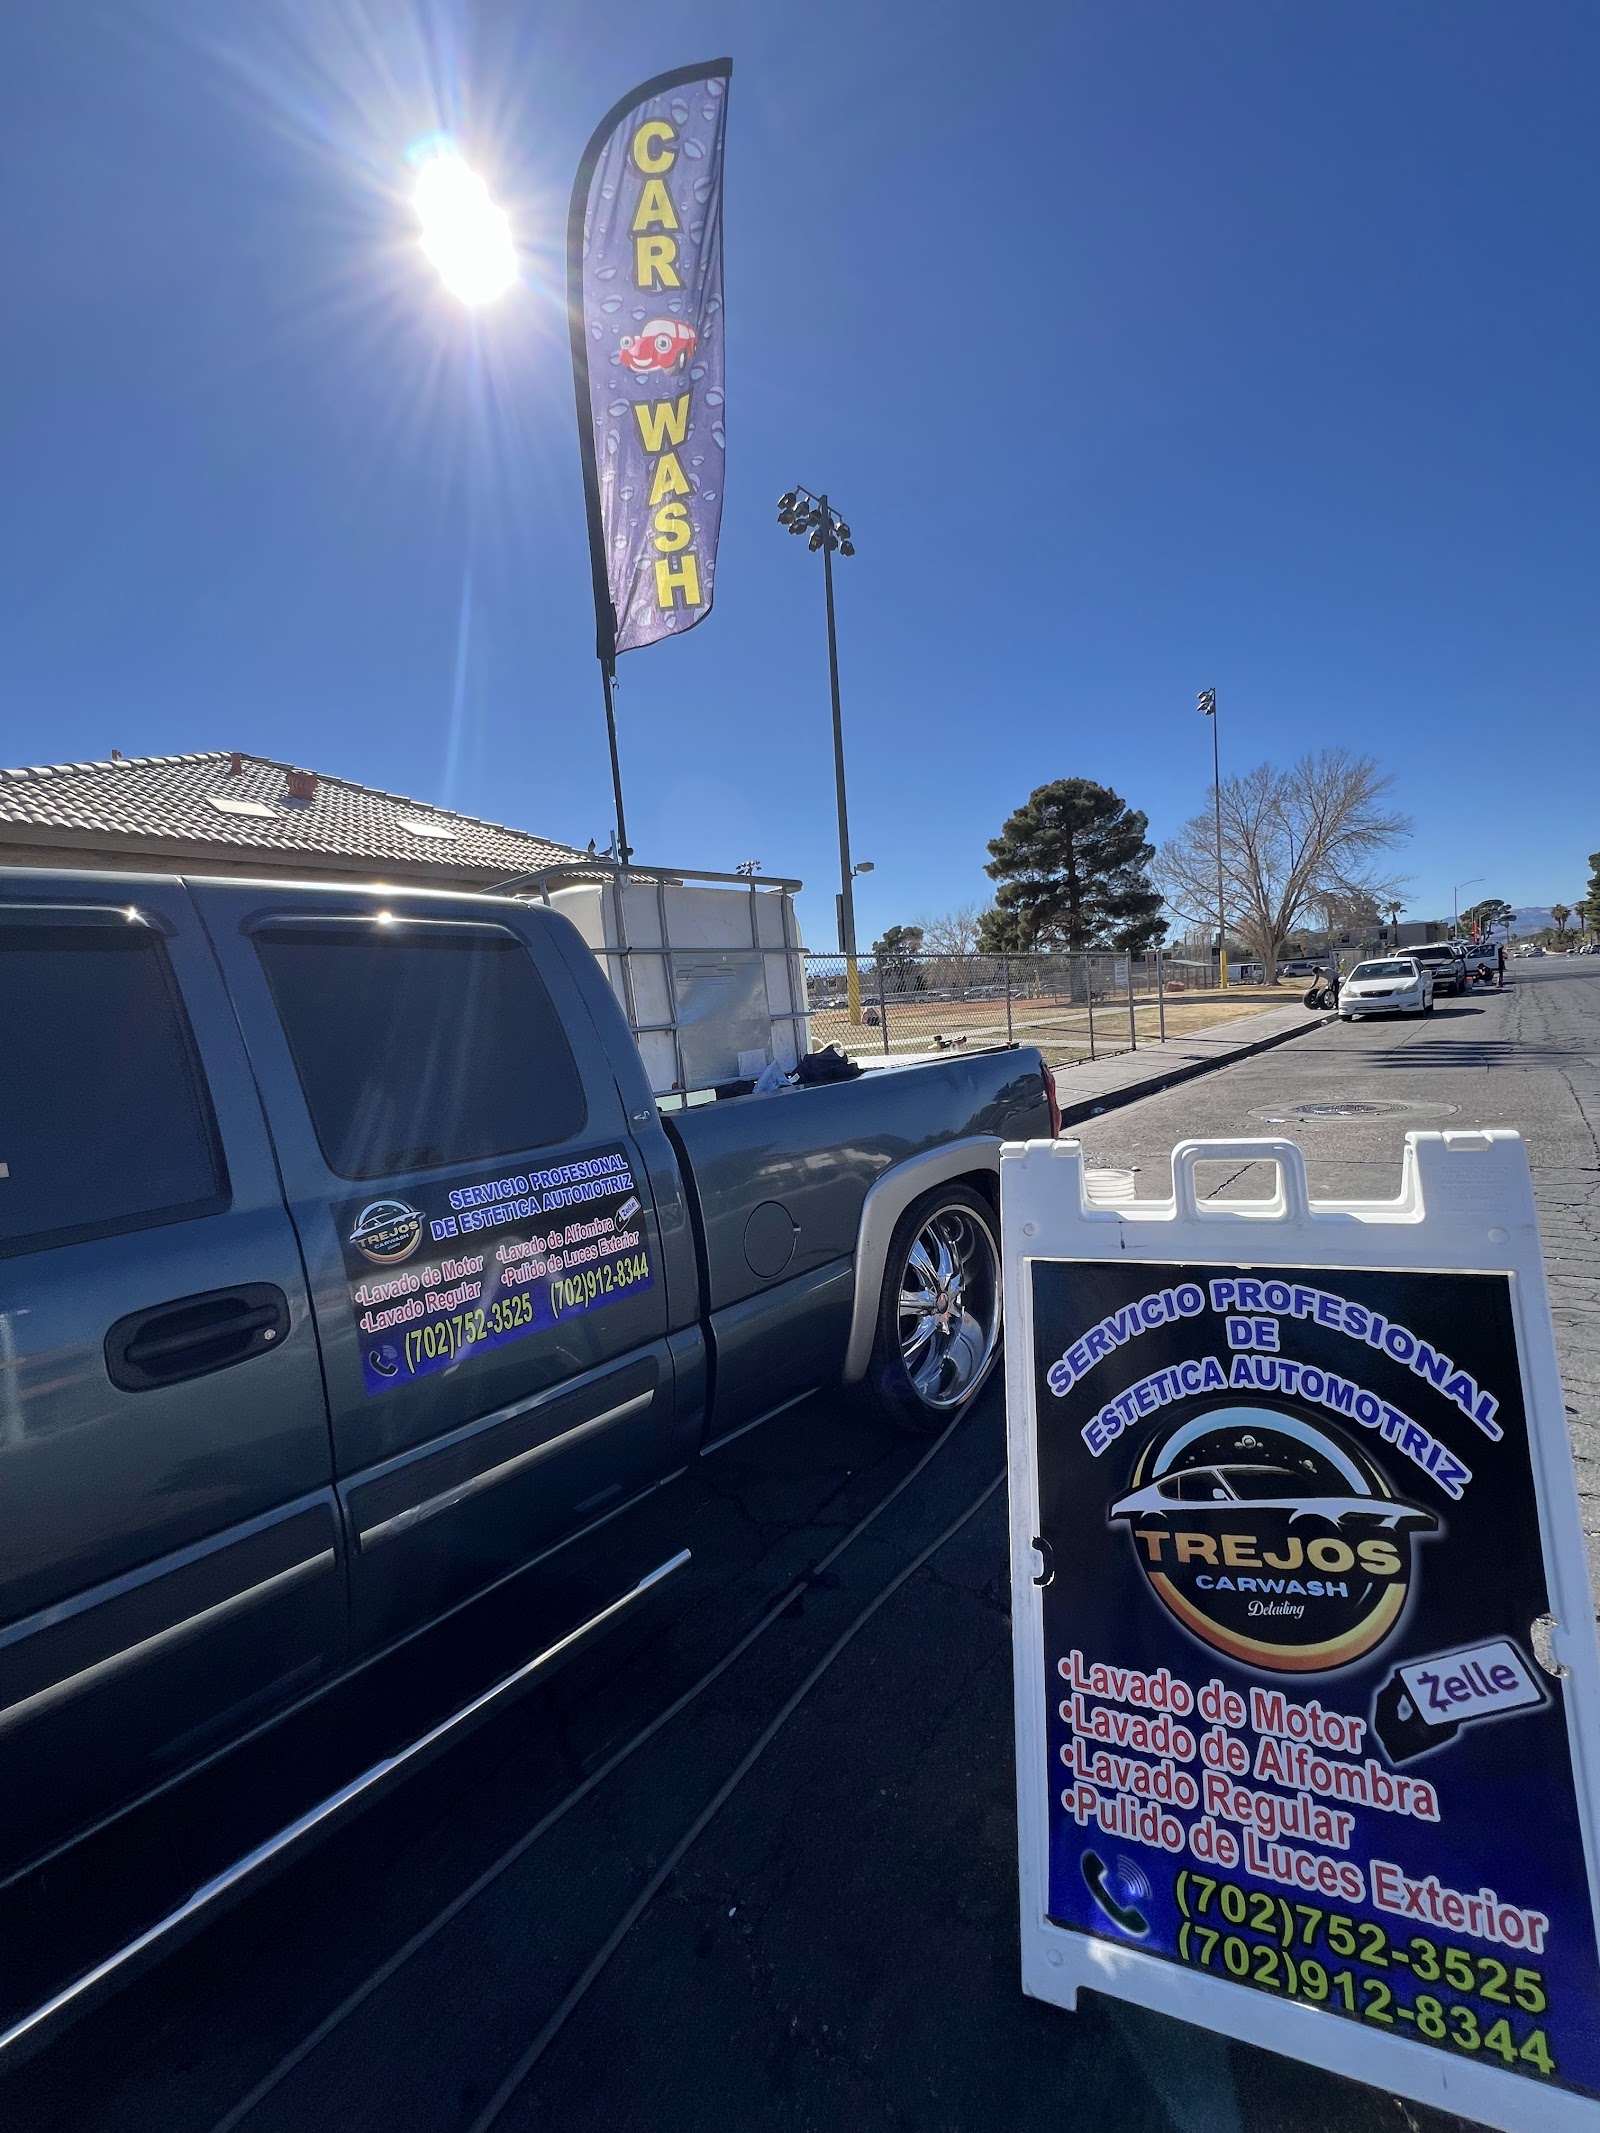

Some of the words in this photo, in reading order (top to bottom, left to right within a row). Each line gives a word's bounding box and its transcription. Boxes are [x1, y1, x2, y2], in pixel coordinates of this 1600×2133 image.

[632, 118, 683, 289] CAR
[634, 393, 704, 608] WASH
[430, 1218, 458, 1240] DE
[459, 1197, 540, 1232] ESTETICA
[543, 1173, 633, 1211] AUTOMOTRIZ
[450, 1176, 529, 1209] SERVICIO
[530, 1154, 628, 1190] PROFESIONAL
[357, 1220, 419, 1248] TREJOS
[374, 1233, 410, 1249] CARWASH
[547, 1231, 564, 1249] de
[565, 1218, 614, 1245] Alfombra
[547, 1255, 563, 1272] de
[564, 1245, 598, 1268] Luces
[599, 1231, 639, 1256] Exterior
[421, 1266, 440, 1288] de
[440, 1255, 484, 1283] Motor
[426, 1281, 482, 1313] Regular
[550, 1251, 649, 1319] (702)912-8344
[404, 1293, 533, 1374] (702)752-3525
[1046, 1283, 1204, 1398] SERVICIO
[1210, 1277, 1504, 1442] PROFESIONAL
[1225, 1317, 1280, 1352] DE
[1081, 1359, 1226, 1458] ESTETICA
[1229, 1354, 1474, 1500] AUTOMOTRIZ
[1135, 1530, 1402, 1576] TREJOS
[1196, 1574, 1349, 1598] CARWASH
[1247, 1600, 1305, 1619] Detailing
[1196, 1678, 1247, 1729] de
[1250, 1685, 1367, 1755] Motor
[1416, 1661, 1520, 1712] Zelle
[1200, 1725, 1249, 1776] de
[1253, 1739, 1441, 1823] Alfombra
[1202, 1770, 1356, 1850] Regular
[1189, 1816, 1239, 1867] de
[1242, 1829, 1365, 1902] Luces
[1370, 1859, 1549, 1954] Exterior
[1175, 1870, 1547, 2013] (702)752-3525
[1177, 1922, 1556, 2075] (702)912-8344
